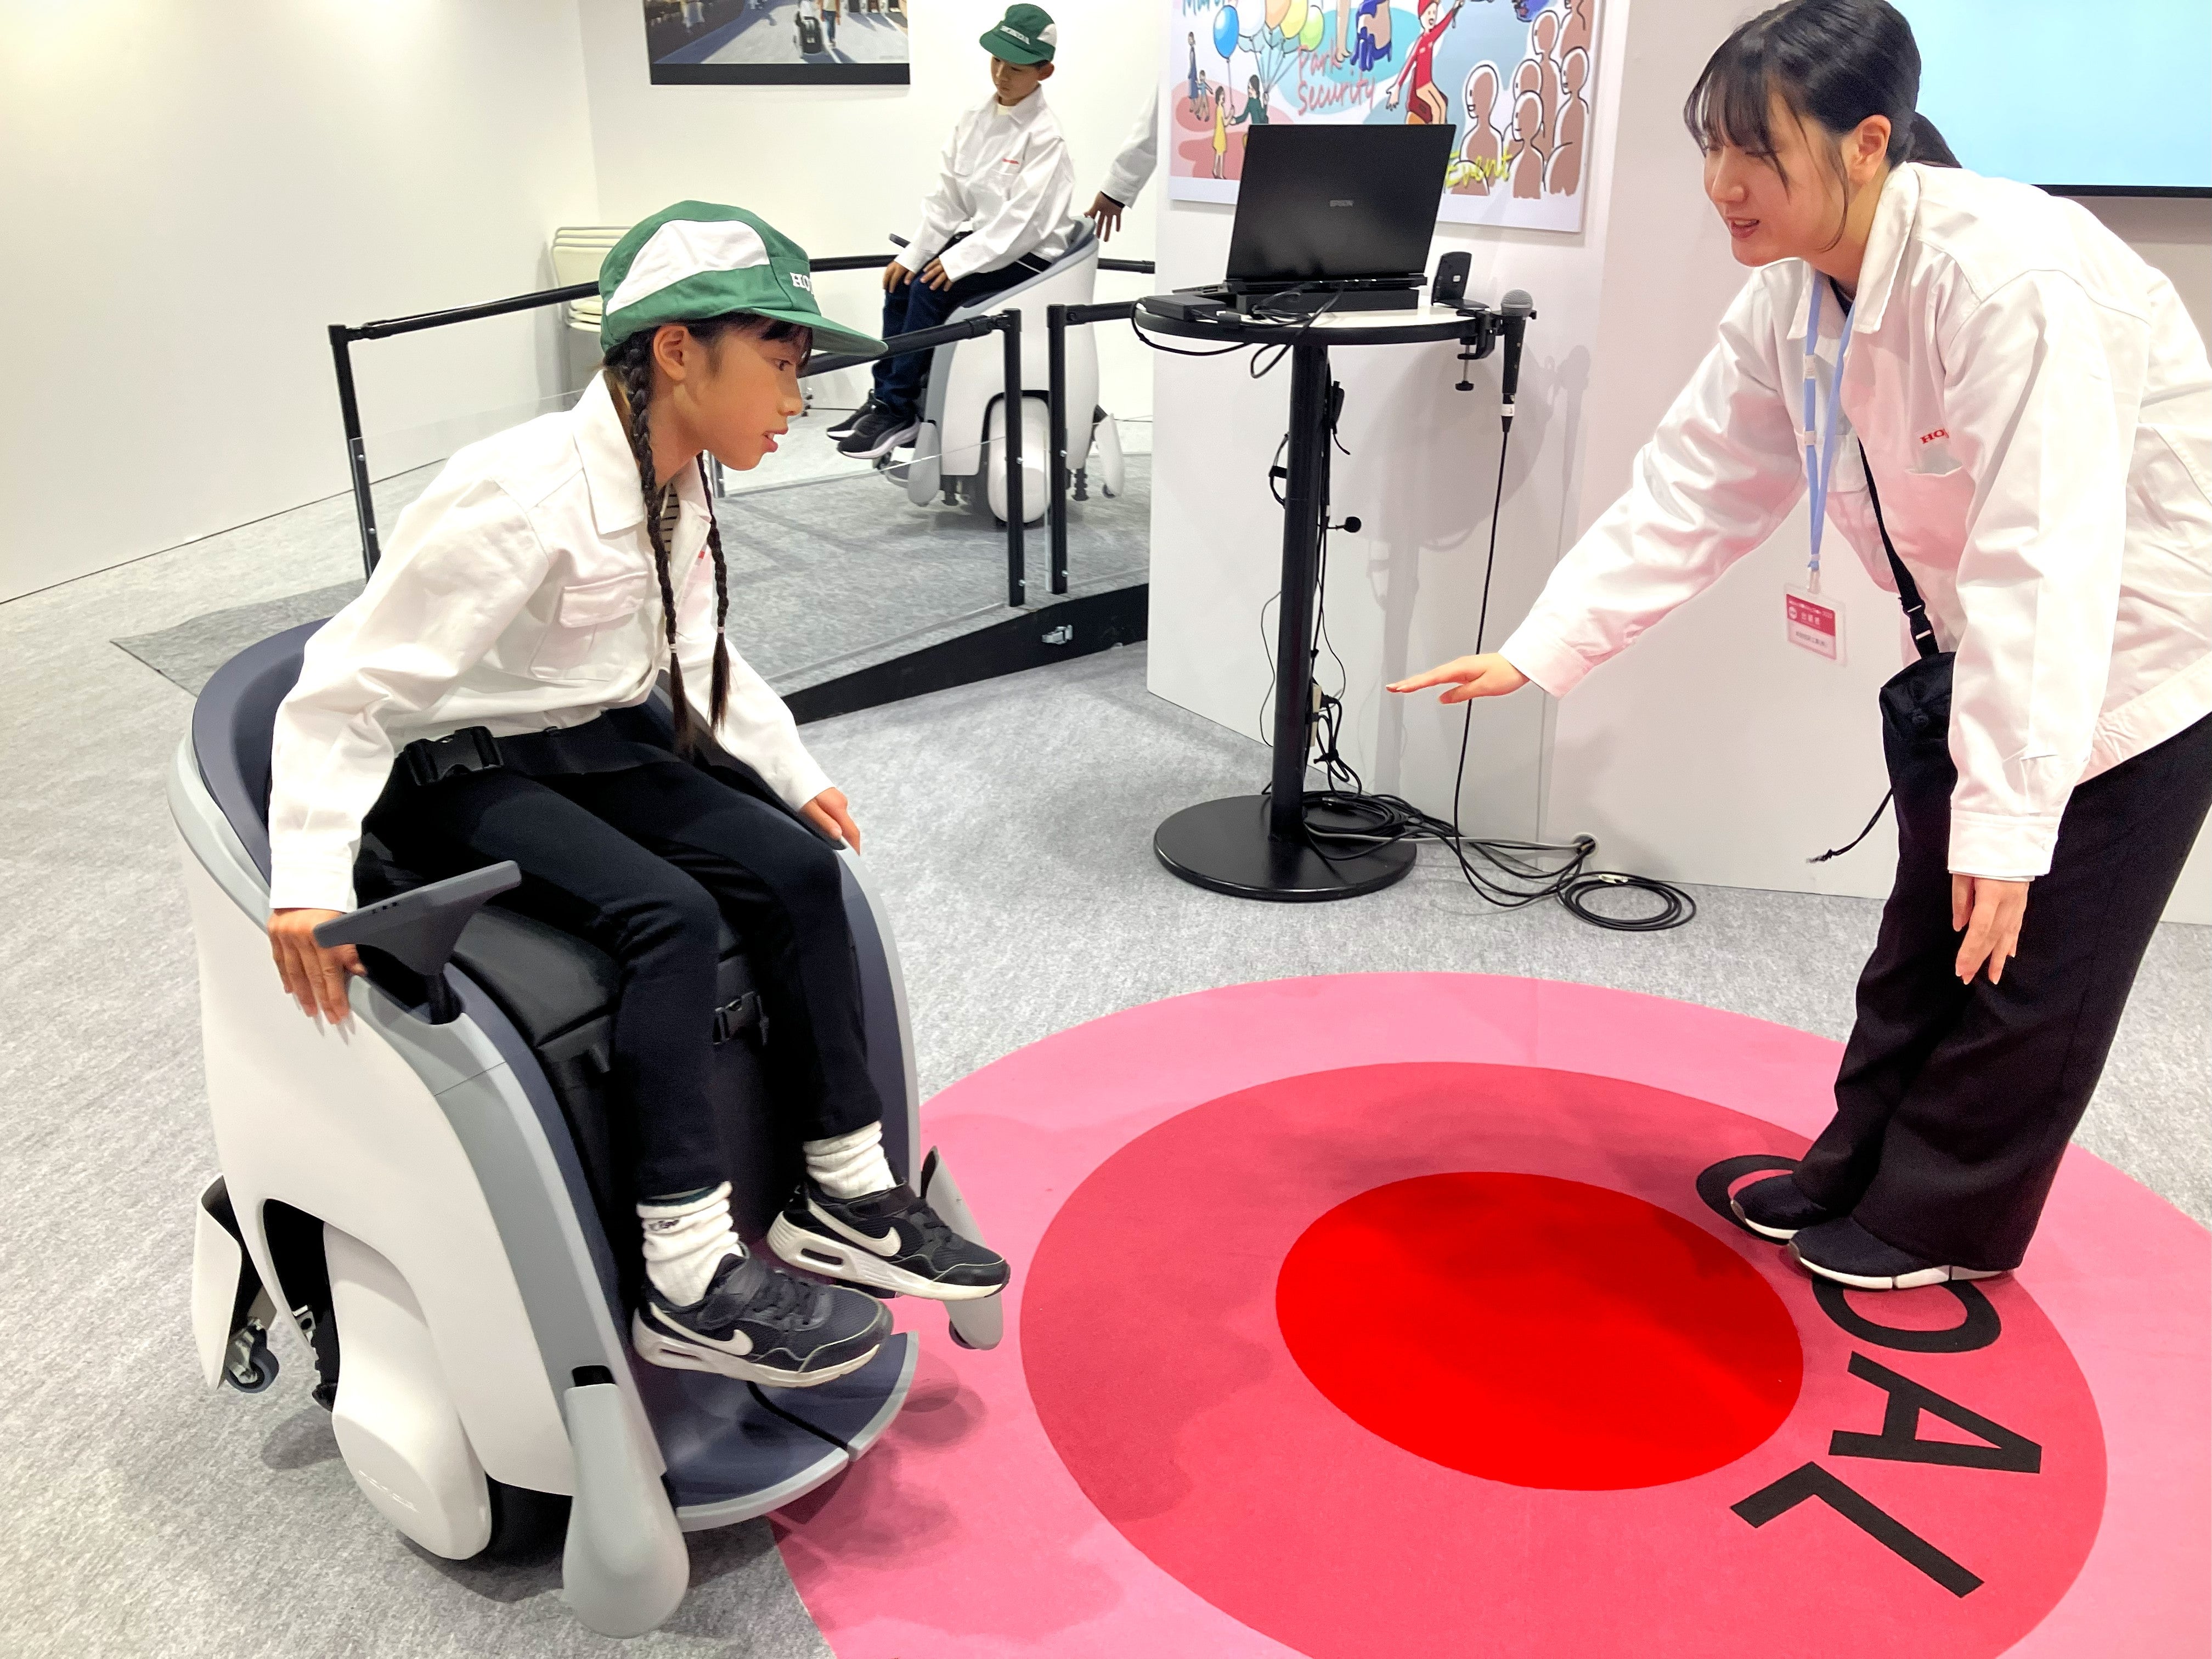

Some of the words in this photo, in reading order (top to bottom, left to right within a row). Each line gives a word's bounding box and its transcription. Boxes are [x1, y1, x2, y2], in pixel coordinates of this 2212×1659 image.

[1297, 38, 1342, 81] Park
[1297, 69, 1375, 116] Security
[1445, 145, 1513, 188] Event
